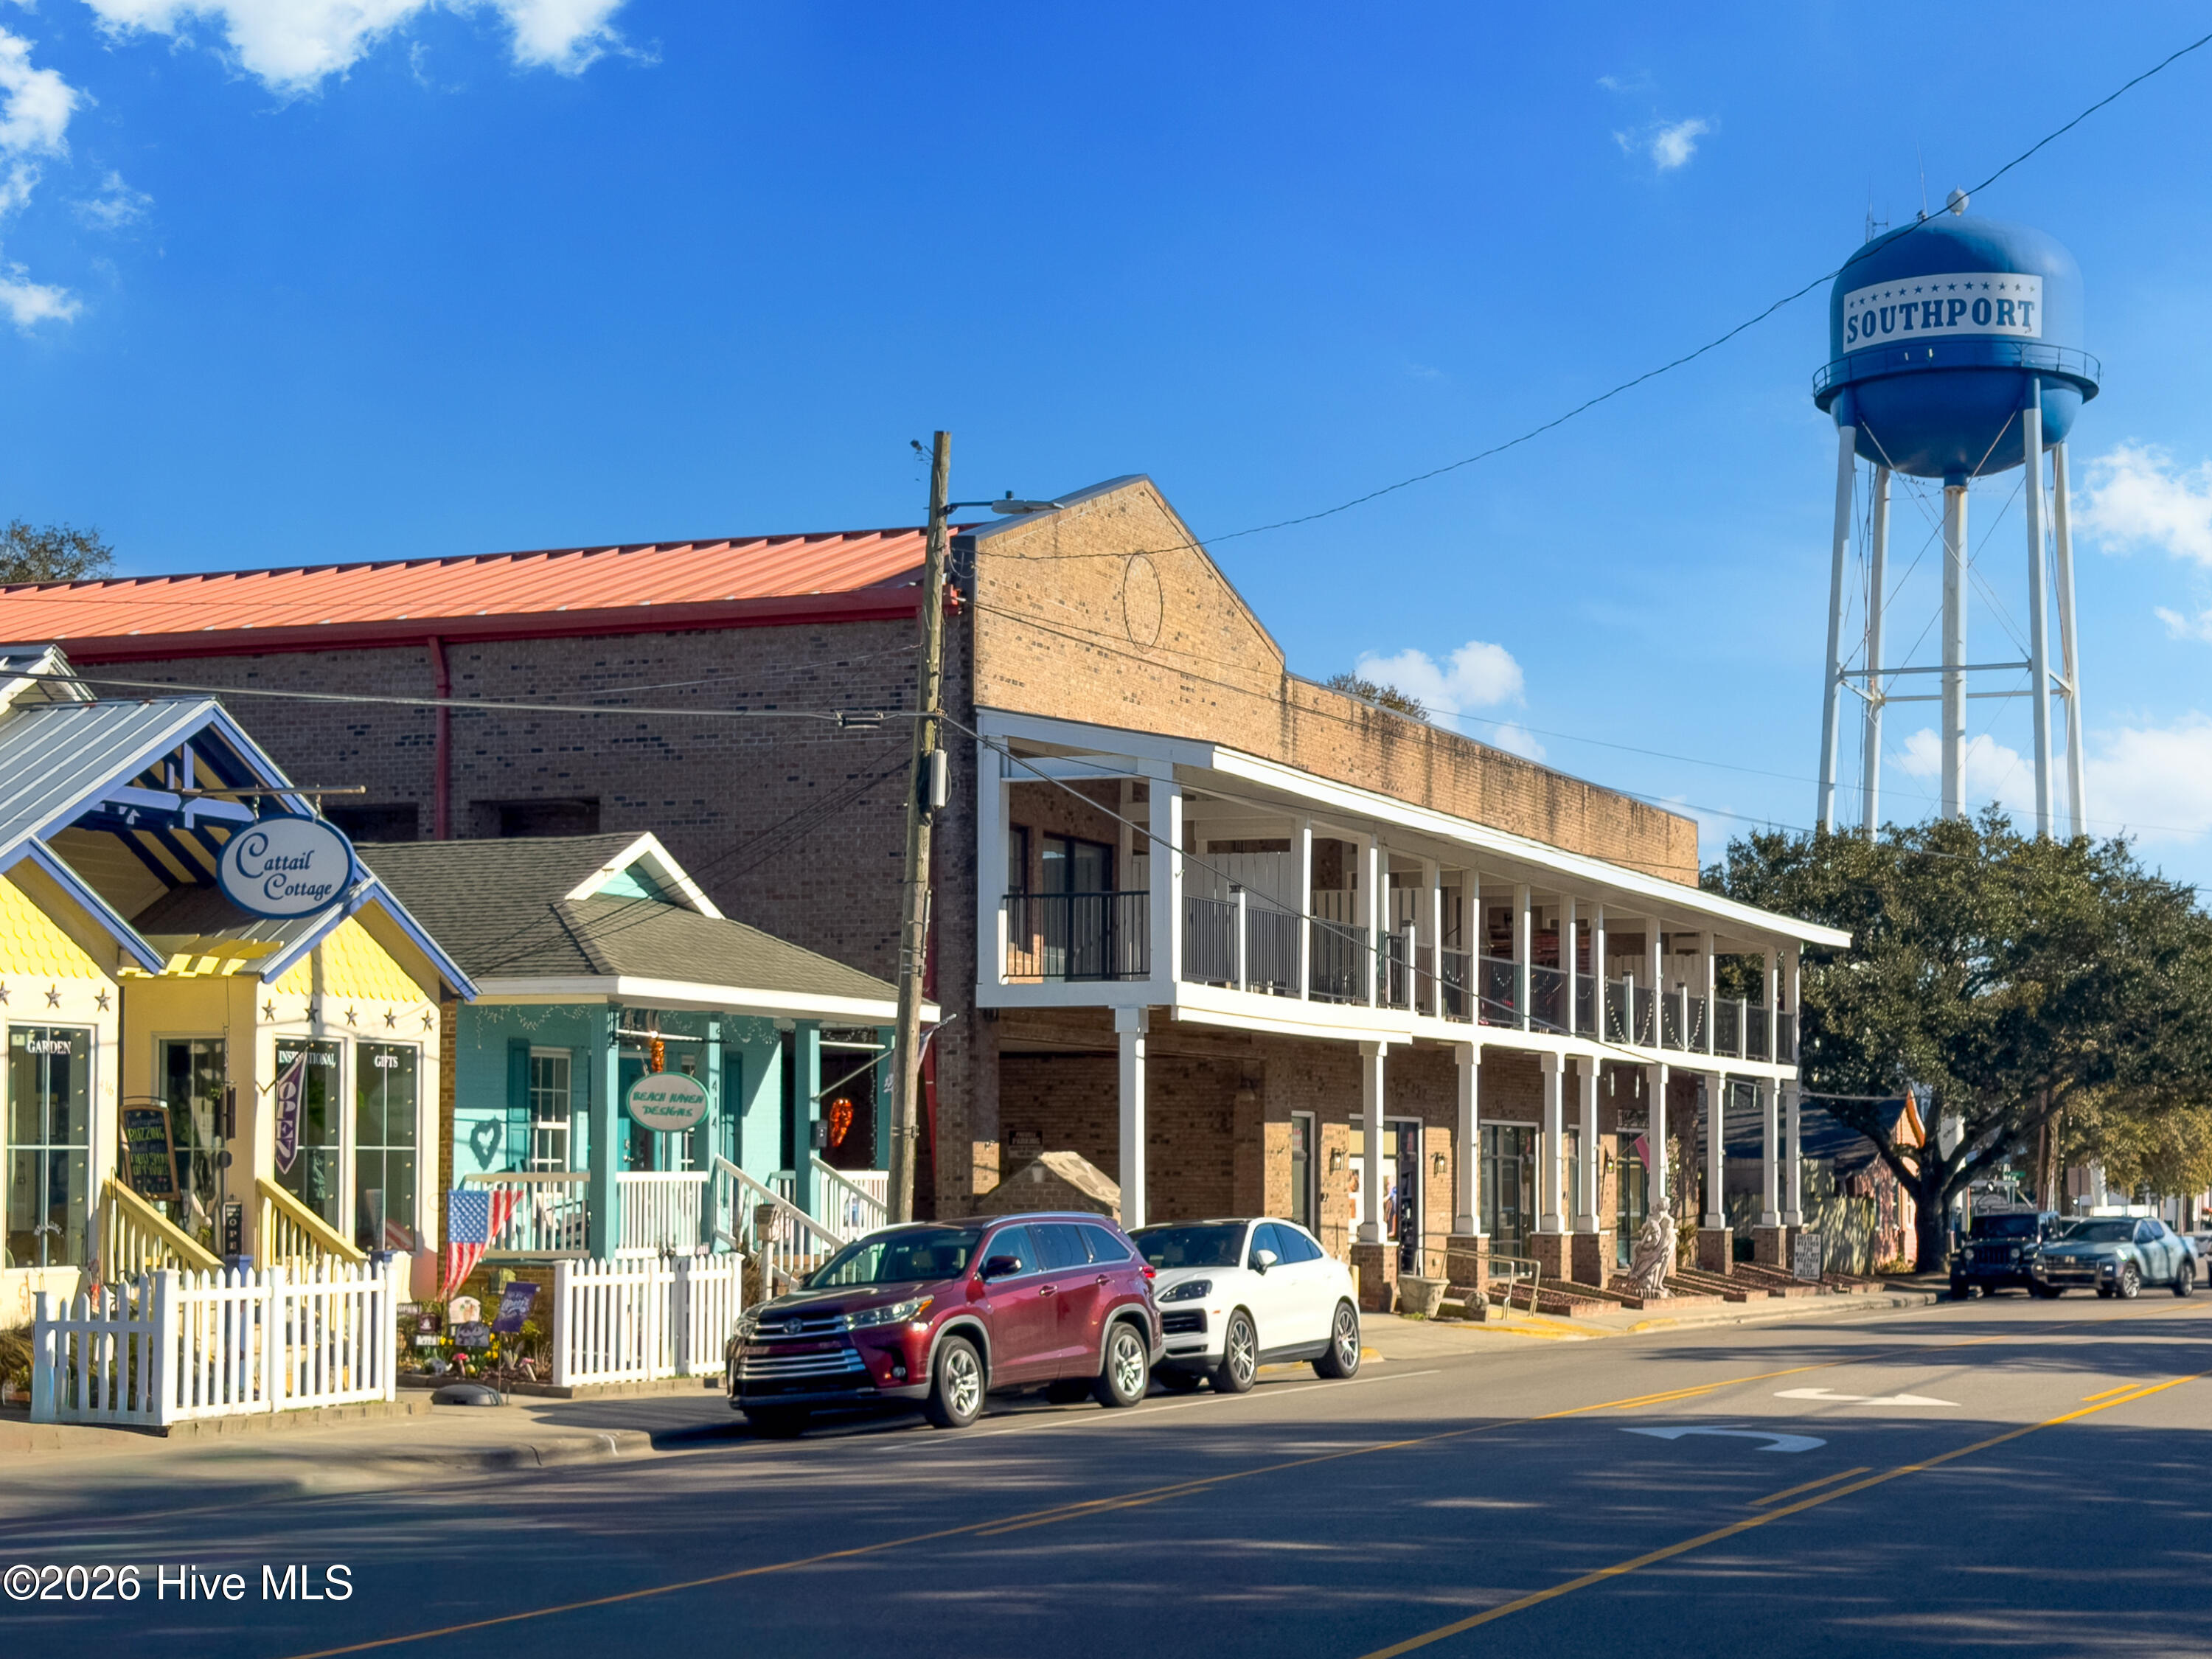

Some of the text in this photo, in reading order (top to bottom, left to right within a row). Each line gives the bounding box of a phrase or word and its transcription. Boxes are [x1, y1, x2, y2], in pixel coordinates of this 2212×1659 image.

[1847, 298, 2035, 344] SOUTHPORT
[236, 832, 315, 879] Cattail
[263, 873, 333, 902] Cottage
[27, 1040, 72, 1054] GARDEN
[278, 1050, 336, 1065] INSPTIONAL
[374, 1055, 399, 1068] GIFTS
[633, 1092, 704, 1104] BEACH HAVEN
[276, 1081, 296, 1159] OPEN
[643, 1105, 692, 1117] DESIGNS
[229, 1218, 237, 1256] OPE
